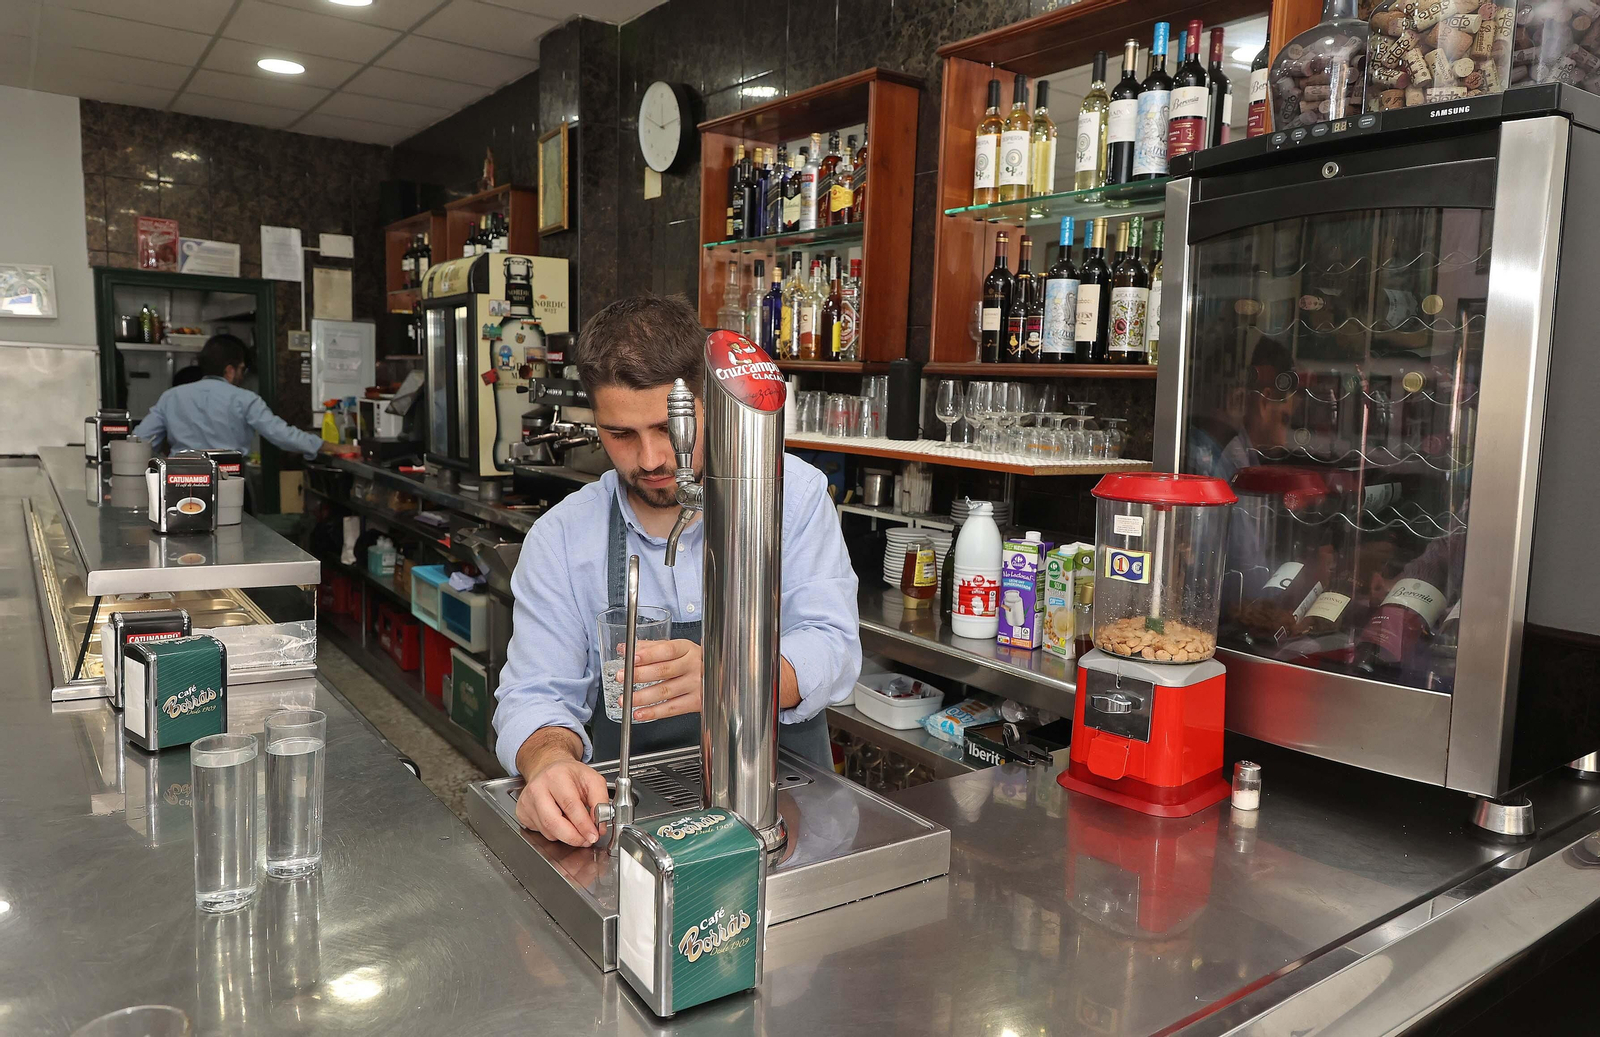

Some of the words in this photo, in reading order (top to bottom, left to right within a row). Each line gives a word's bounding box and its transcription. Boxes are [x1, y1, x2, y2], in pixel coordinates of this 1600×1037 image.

[1430, 105, 1470, 118] SAMSUNG
[534, 300, 567, 309] NORDIC
[715, 361, 780, 380] Cruzcampo
[1392, 586, 1434, 604] Beronia
[178, 684, 197, 699] Café
[670, 816, 693, 827] Café
[716, 822, 735, 831] 1909
[699, 906, 725, 931] Café
[730, 937, 750, 950] 1909
